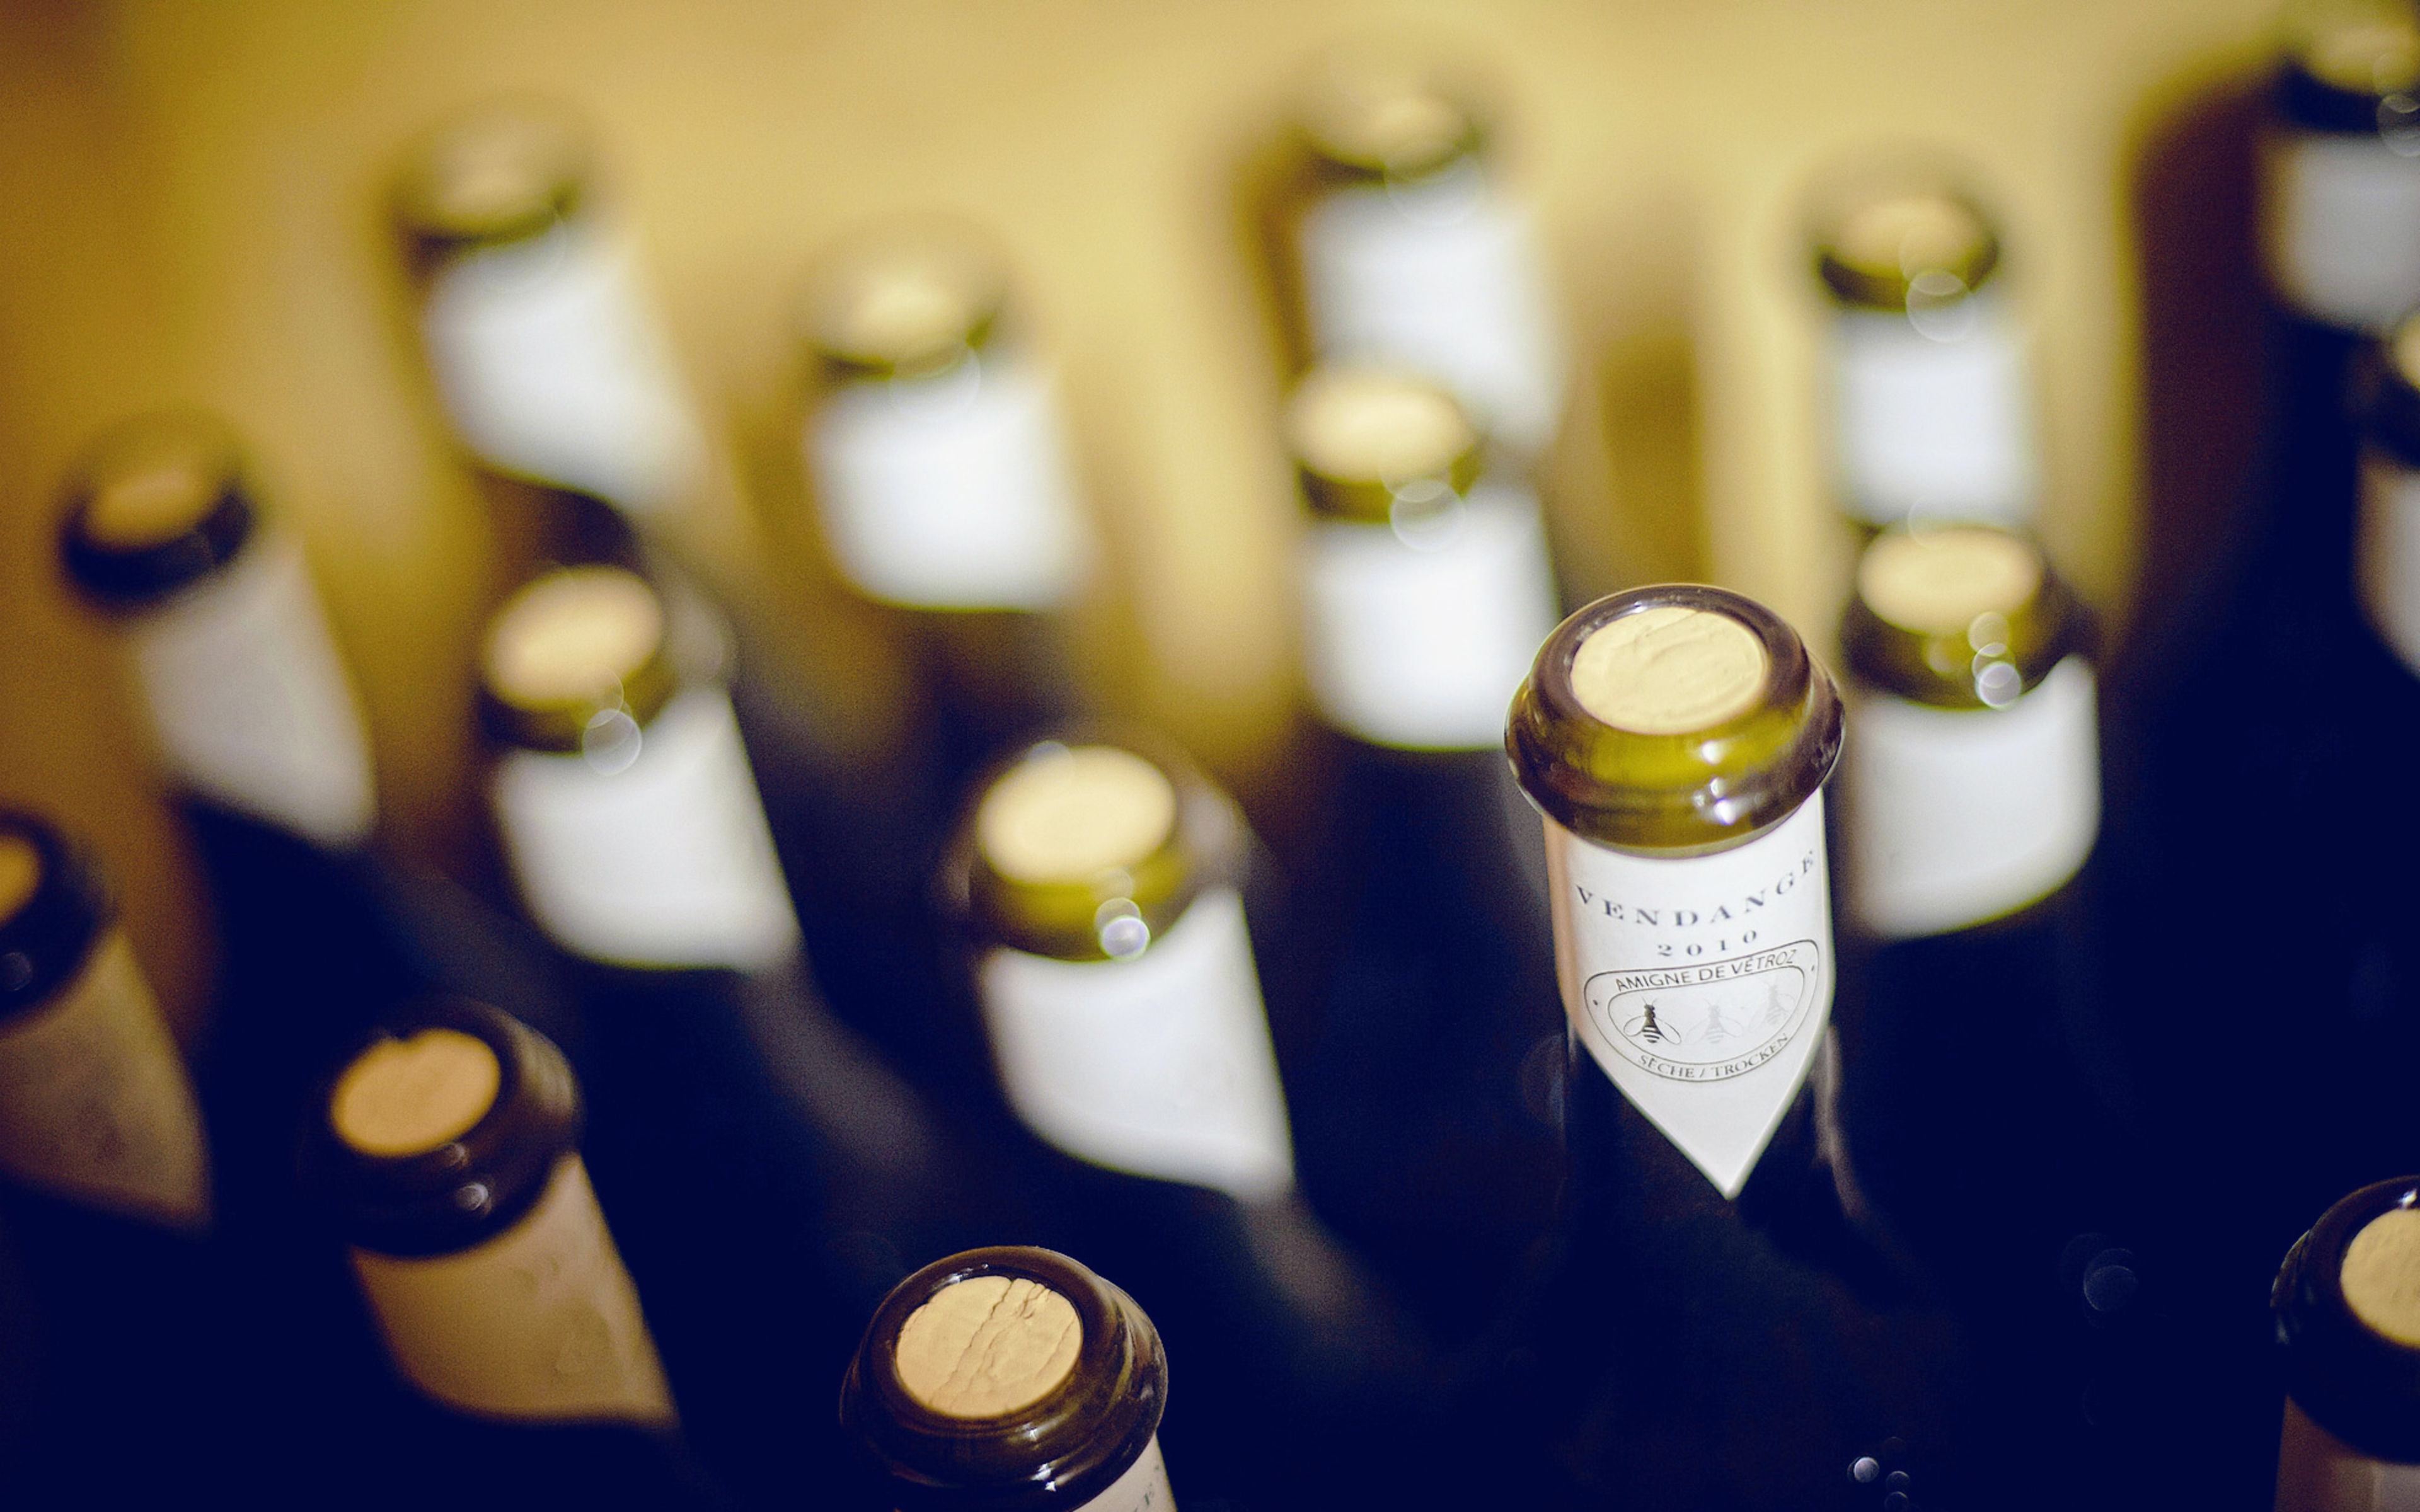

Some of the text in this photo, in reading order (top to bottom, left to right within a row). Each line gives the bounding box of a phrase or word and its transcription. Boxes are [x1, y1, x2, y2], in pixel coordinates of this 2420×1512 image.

[1576, 850, 1814, 927] VENDANGE
[1658, 930, 1757, 957] 2010
[1615, 971, 1691, 992] AMIGNE
[1699, 965, 1726, 981] DE
[1711, 1033, 1788, 1077] TROCKEN
